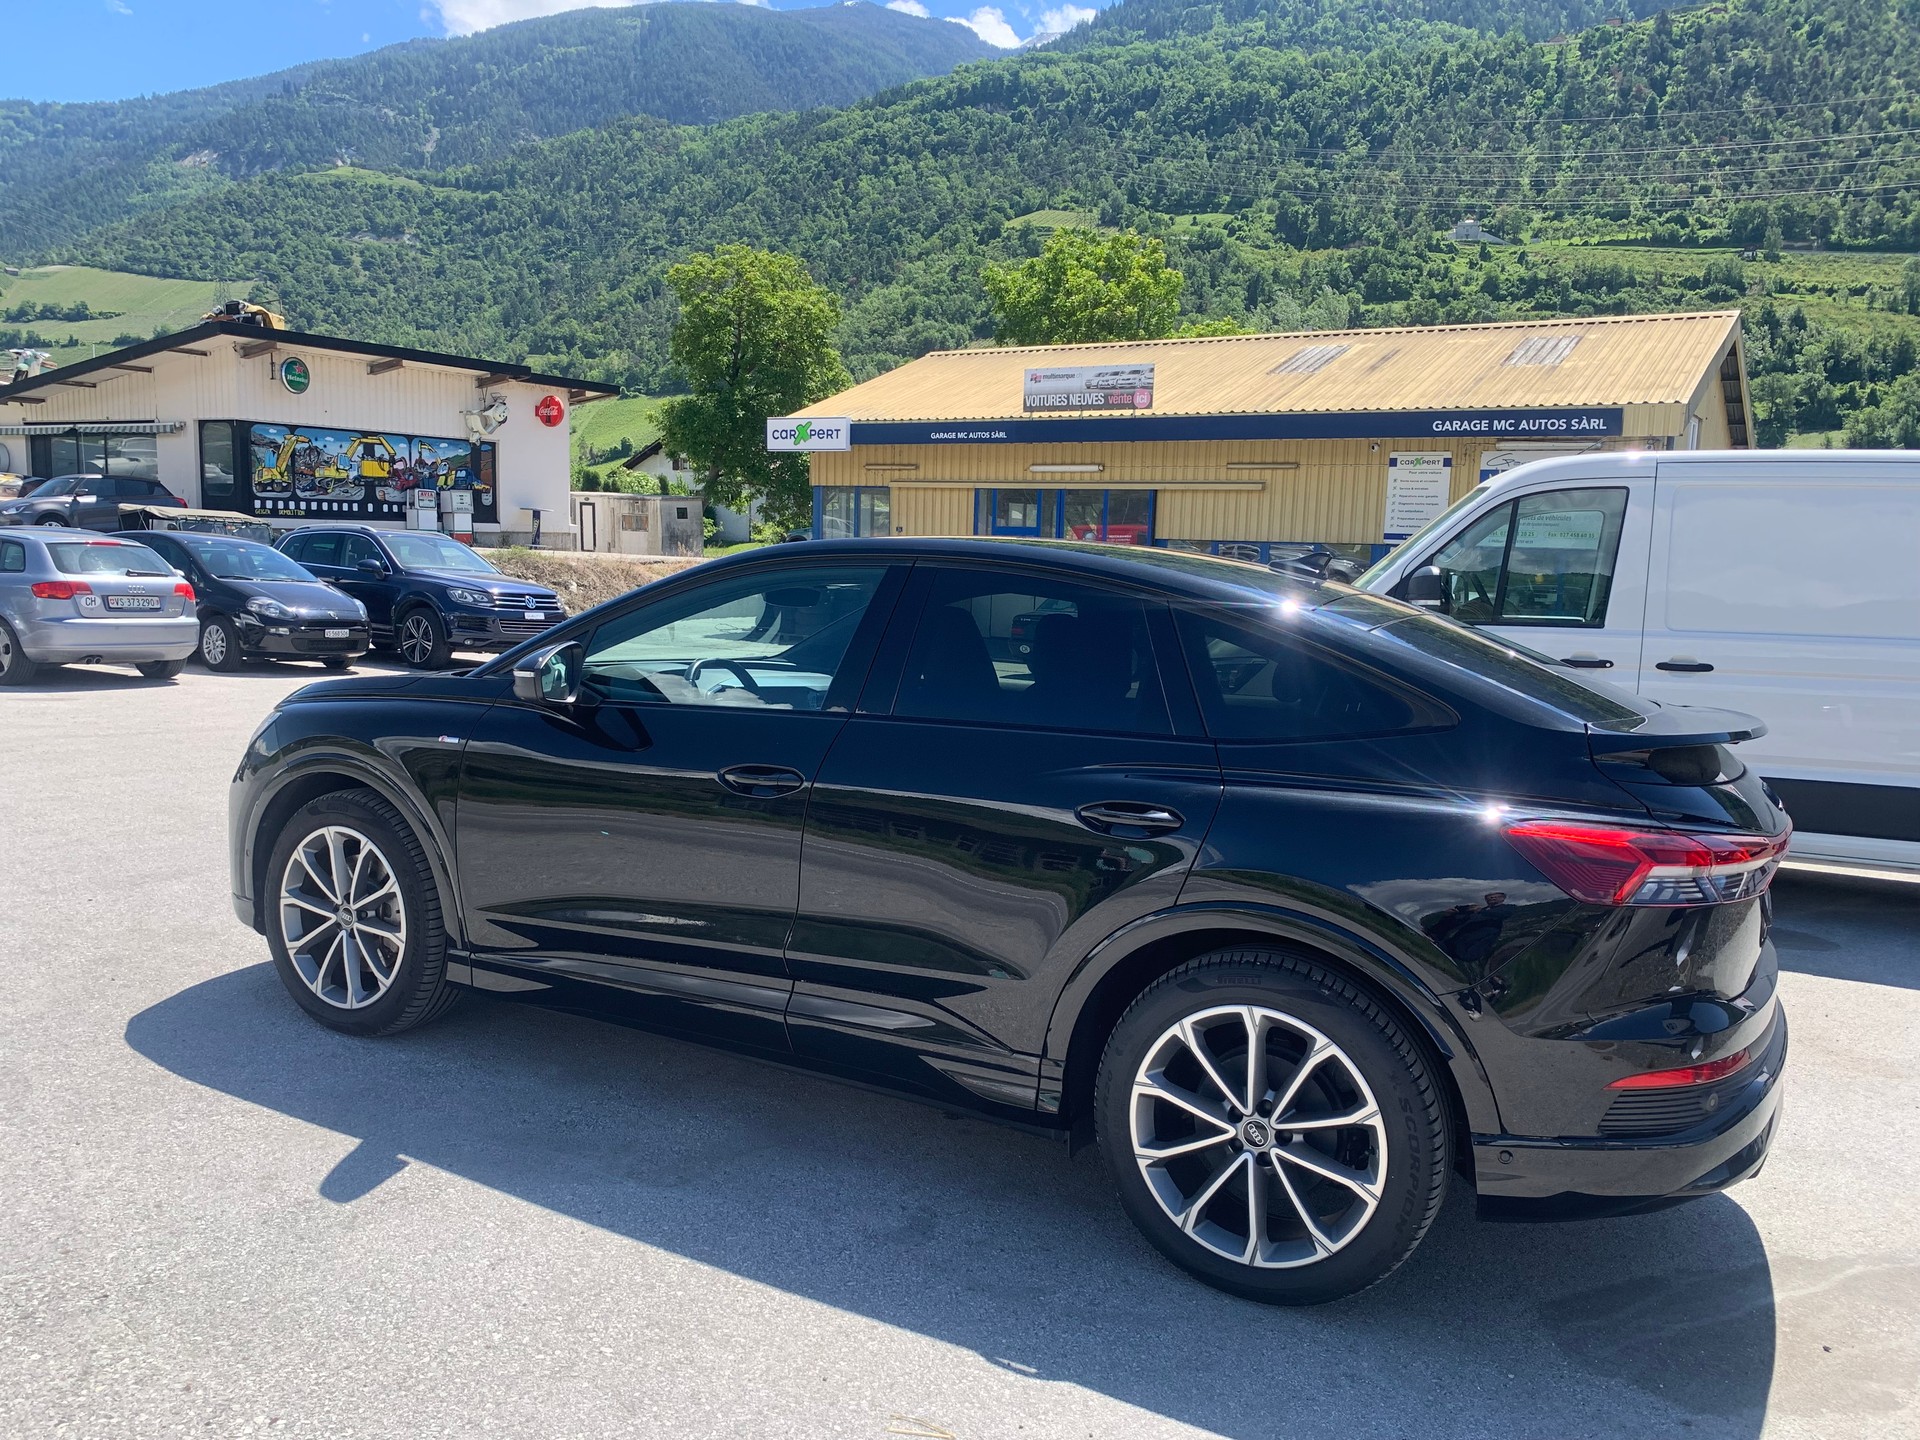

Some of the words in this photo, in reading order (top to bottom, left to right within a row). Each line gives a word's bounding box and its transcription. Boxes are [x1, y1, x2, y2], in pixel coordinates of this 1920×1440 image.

[1025, 394, 1068, 407] VOITURES
[1069, 392, 1105, 406] NEUVES
[1108, 394, 1133, 405] vente
[1136, 391, 1148, 404] ici
[1432, 420, 1490, 432] GARAGE
[1493, 420, 1516, 431] MC
[1519, 419, 1567, 431] AUTOS
[1570, 416, 1608, 430] SÀRL
[930, 432, 956, 440] GARAGE
[969, 431, 990, 439] AUTOS
[991, 430, 1008, 439] SÀRL
[85, 597, 97, 606] CH
[115, 598, 124, 606] VS
[1394, 1094, 1422, 1235] SCORPION
